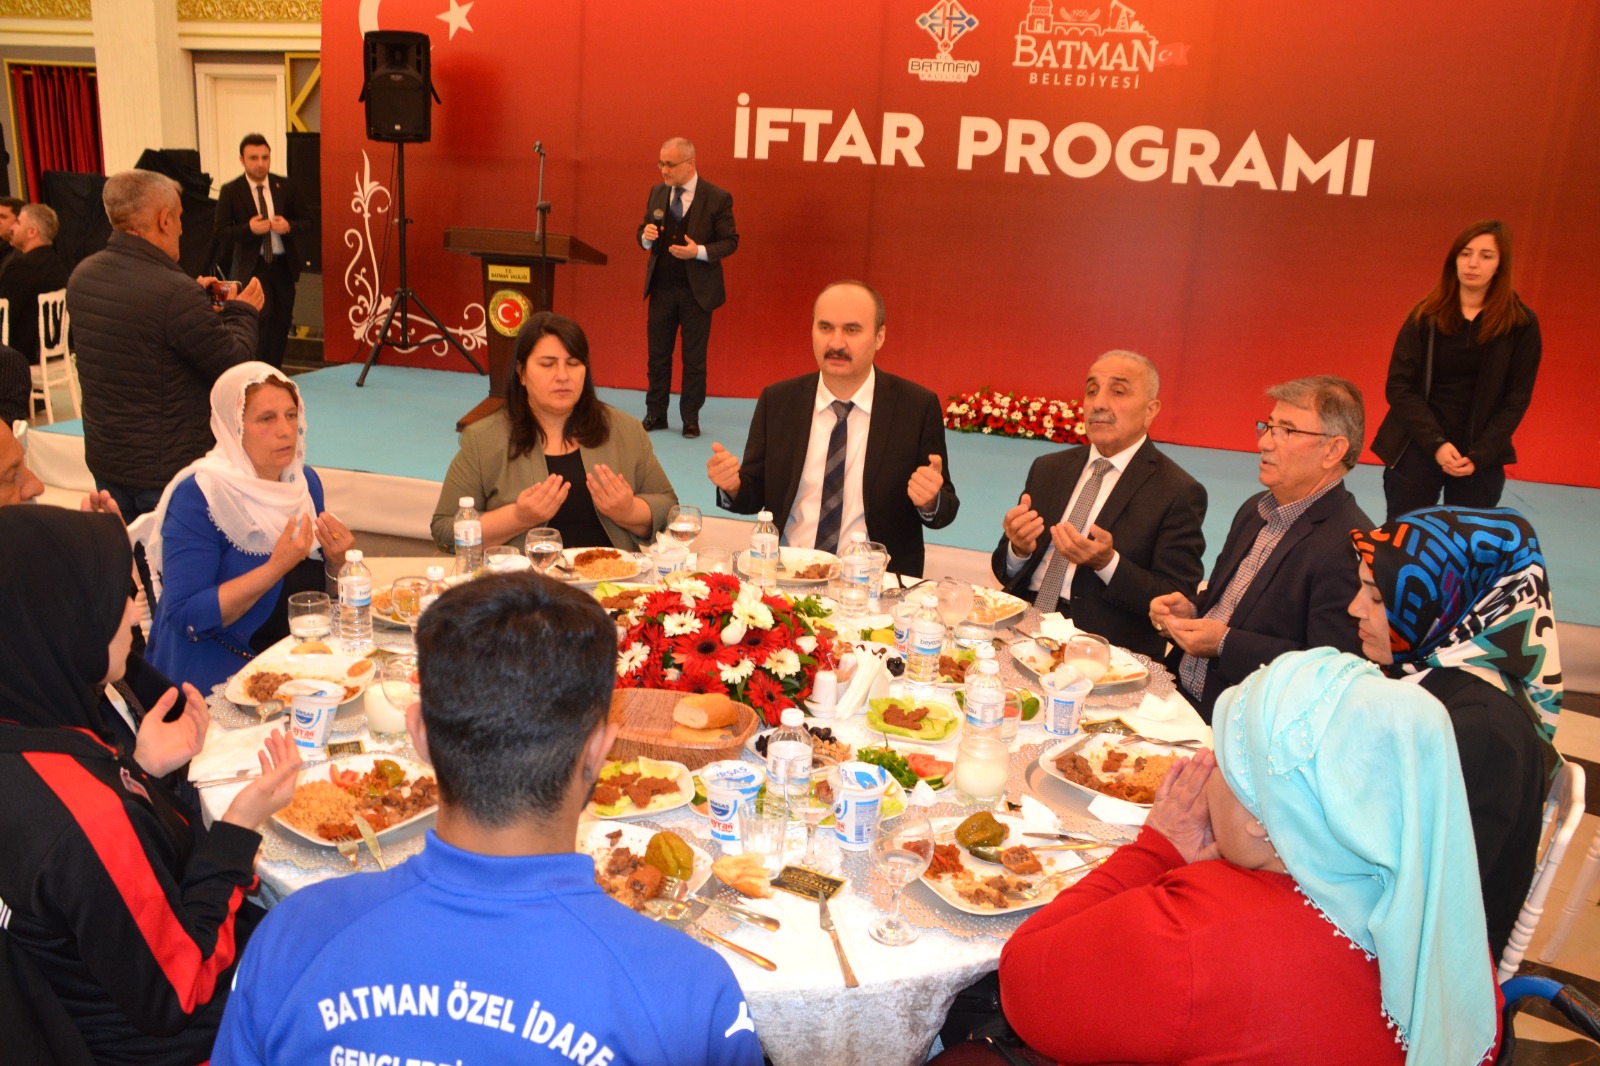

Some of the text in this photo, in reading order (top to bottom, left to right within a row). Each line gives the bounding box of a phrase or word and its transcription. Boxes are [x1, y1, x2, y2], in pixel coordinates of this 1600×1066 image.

[910, 60, 978, 74] BATMAN
[1012, 34, 1159, 73] BATMAN
[1029, 72, 1140, 89] BELEDİYESİ
[733, 92, 1376, 197] İFTAR PROGRAMI
[317, 983, 440, 1032] BATMAN
[446, 980, 516, 1034] ÖZEL
[521, 1000, 615, 1066] İDARE
